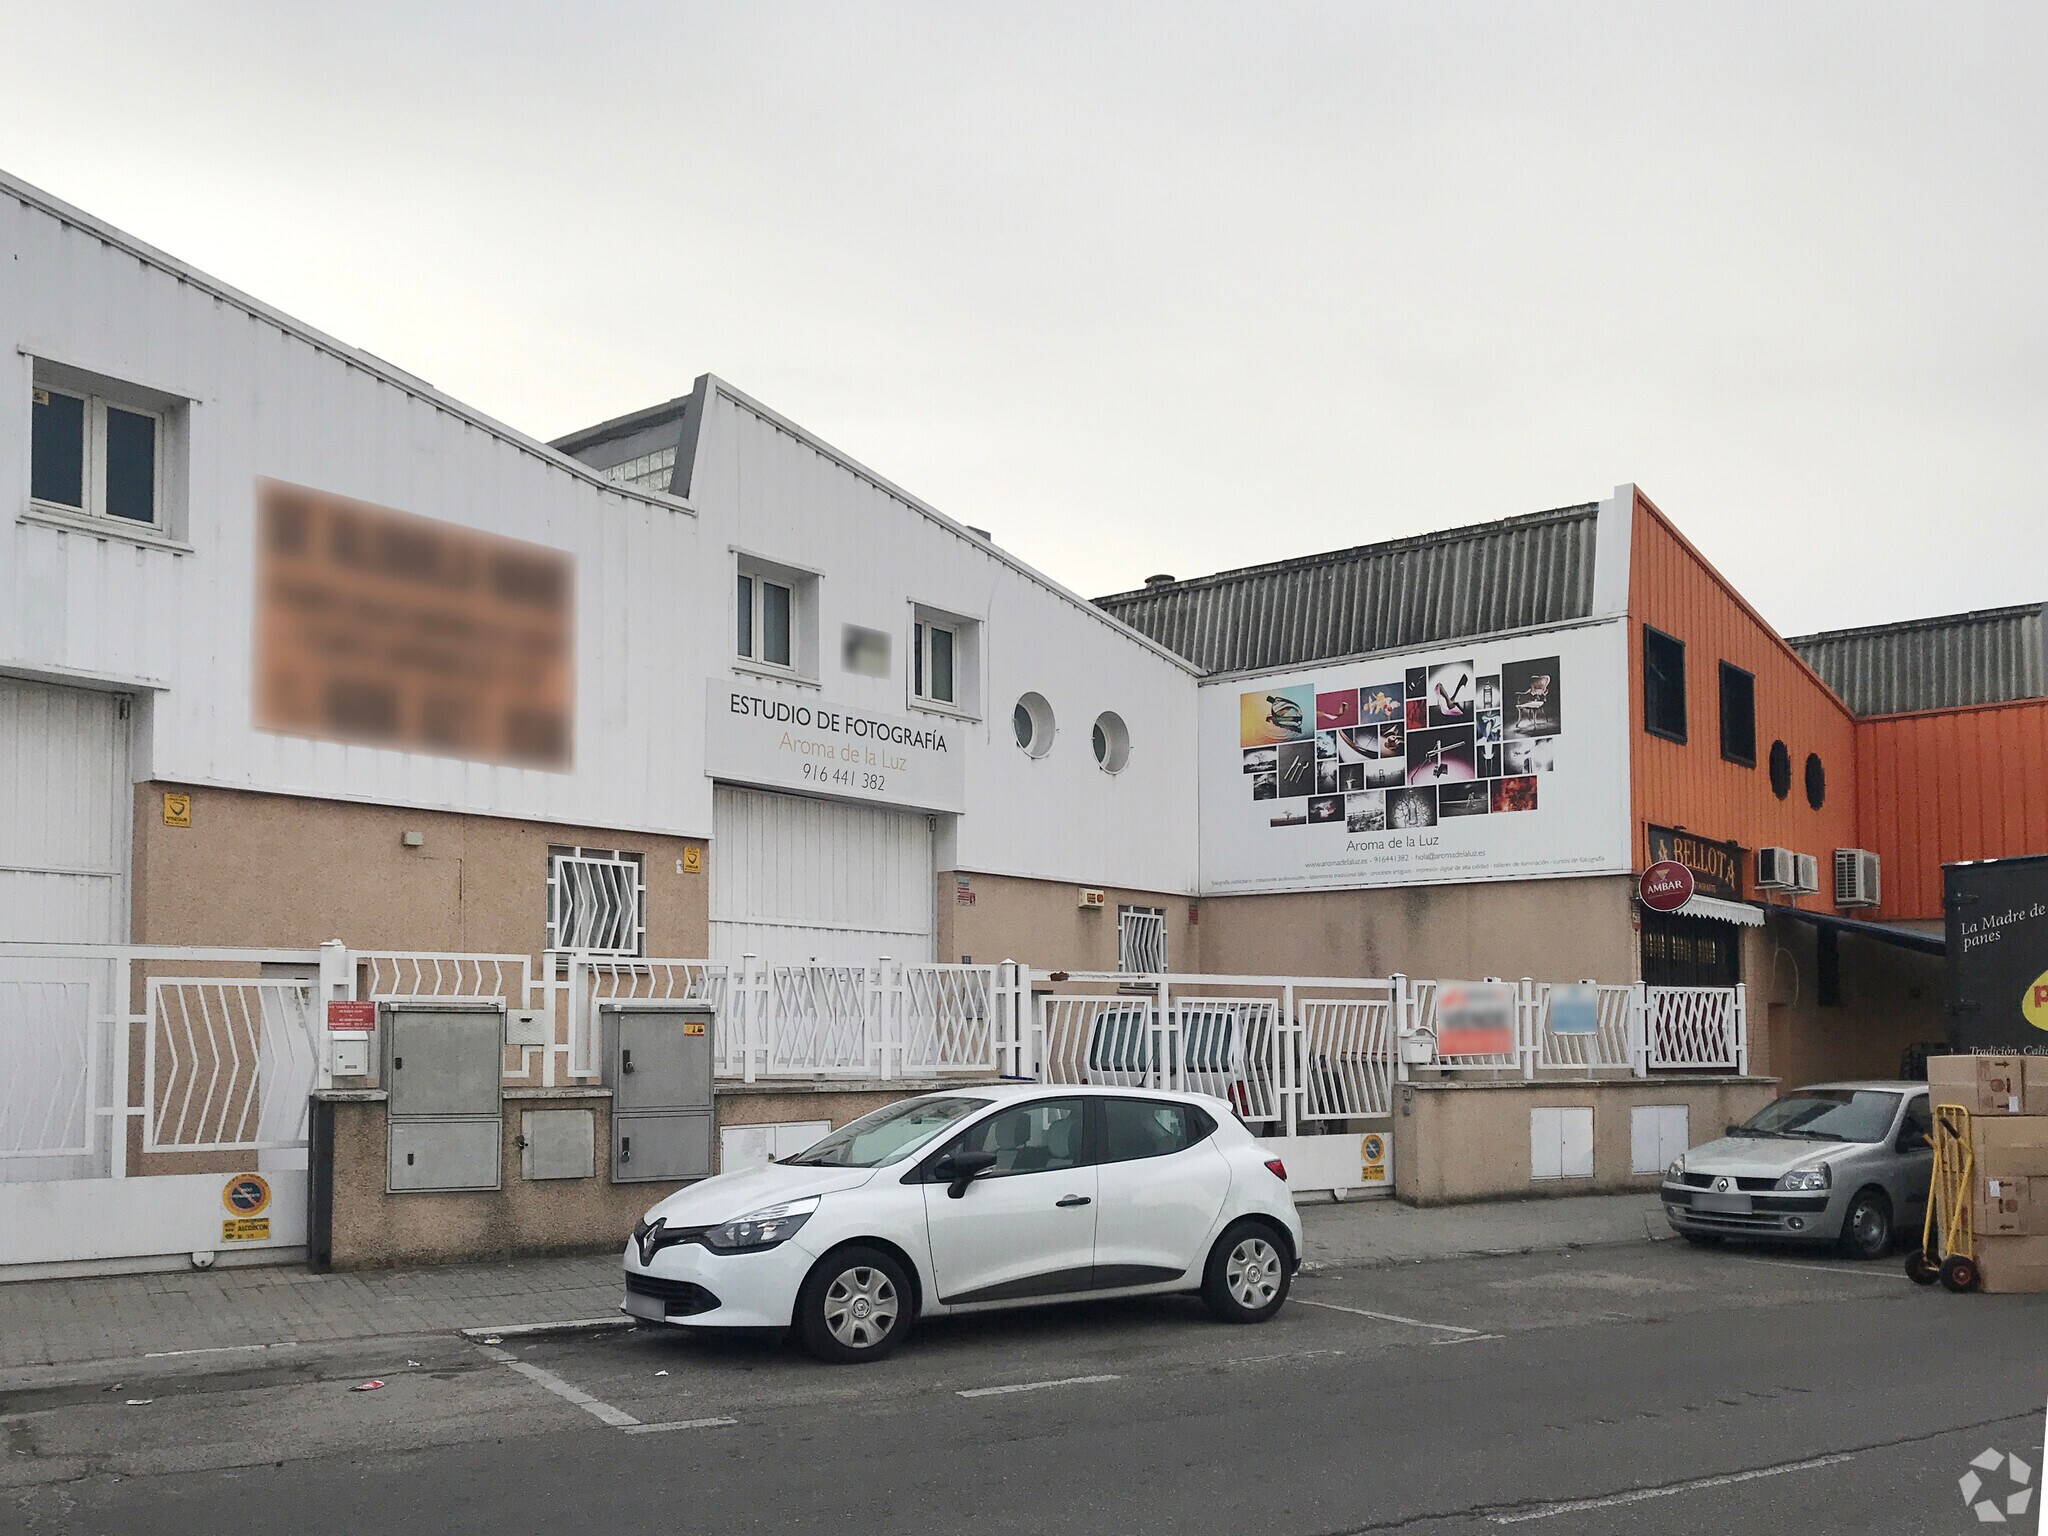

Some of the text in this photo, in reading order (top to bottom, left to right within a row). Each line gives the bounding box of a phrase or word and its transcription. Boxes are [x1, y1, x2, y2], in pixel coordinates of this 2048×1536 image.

[730, 693, 947, 752] ESTUDIO DE FOTOGRAFÍA
[779, 732, 907, 771] Aroma de la Luz
[803, 763, 885, 791] 916 441 382
[1346, 834, 1439, 851] Aroma de la Luz
[1305, 850, 1486, 868] www.aromadelaluz.es 916441382 hola@aromadelaluz.es
[1673, 837, 1736, 891] BELLOTA
[1647, 880, 1684, 894] AMBAR
[1961, 902, 2046, 936] La Madre de
[1963, 930, 2001, 952] panes
